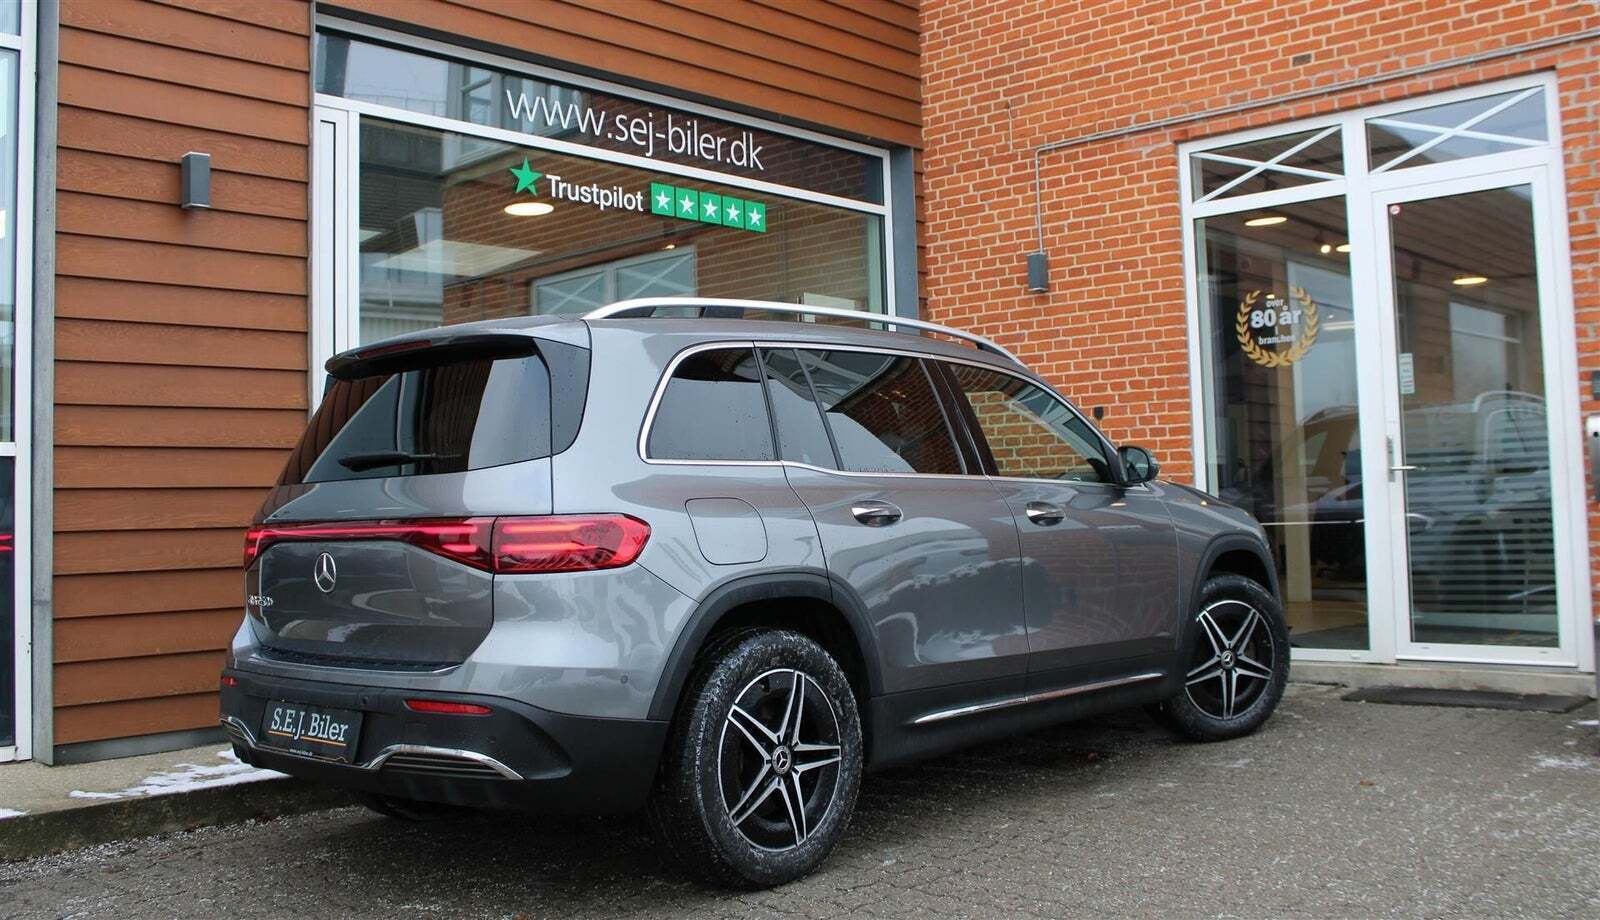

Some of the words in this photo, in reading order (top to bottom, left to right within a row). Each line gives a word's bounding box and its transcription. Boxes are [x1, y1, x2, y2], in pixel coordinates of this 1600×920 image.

[506, 89, 764, 171] www.sej-biler.dk
[545, 174, 644, 212] Trustpilot
[1250, 308, 1277, 329] 80
[1279, 305, 1302, 326] år
[271, 707, 305, 740] S.E.J.
[308, 712, 349, 742] Biler
